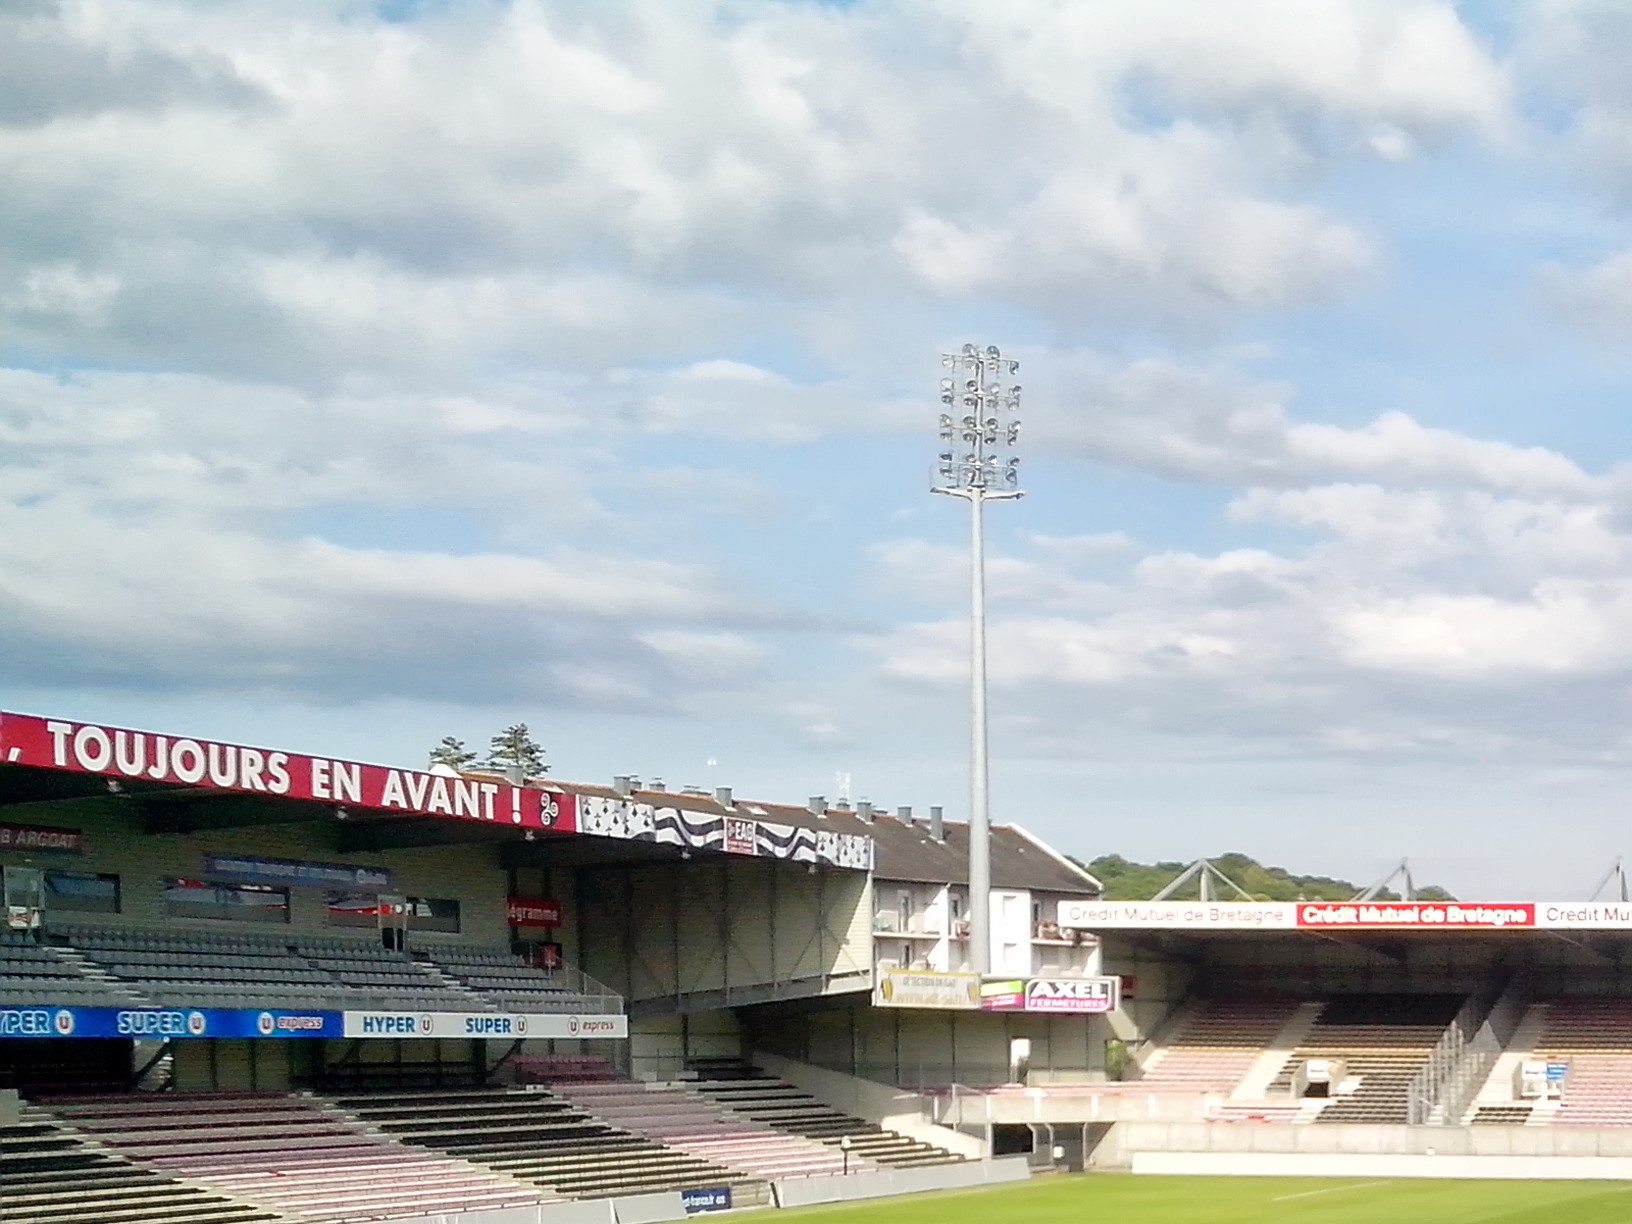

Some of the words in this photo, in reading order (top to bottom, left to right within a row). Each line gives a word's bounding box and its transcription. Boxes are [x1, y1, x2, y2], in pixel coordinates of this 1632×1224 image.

[47, 721, 291, 794] TOUJOURS
[310, 758, 362, 803] EN
[382, 769, 498, 820] AVANT
[511, 787, 522, 824] !
[1124, 907, 1179, 921] Mutuel
[1184, 907, 1203, 921] de
[1210, 908, 1283, 924] Bretagne
[1359, 906, 1419, 923] Mutuel
[1420, 906, 1445, 923] de
[1446, 906, 1527, 926] Bretagne
[1030, 981, 1107, 998] AXEL
[1030, 999, 1107, 1009] FERMETURES
[117, 1011, 186, 1034] SUPER
[277, 1016, 323, 1032] express
[363, 1016, 415, 1033] HYPER
[465, 1016, 511, 1033] SUPER
[582, 1019, 614, 1034] express
